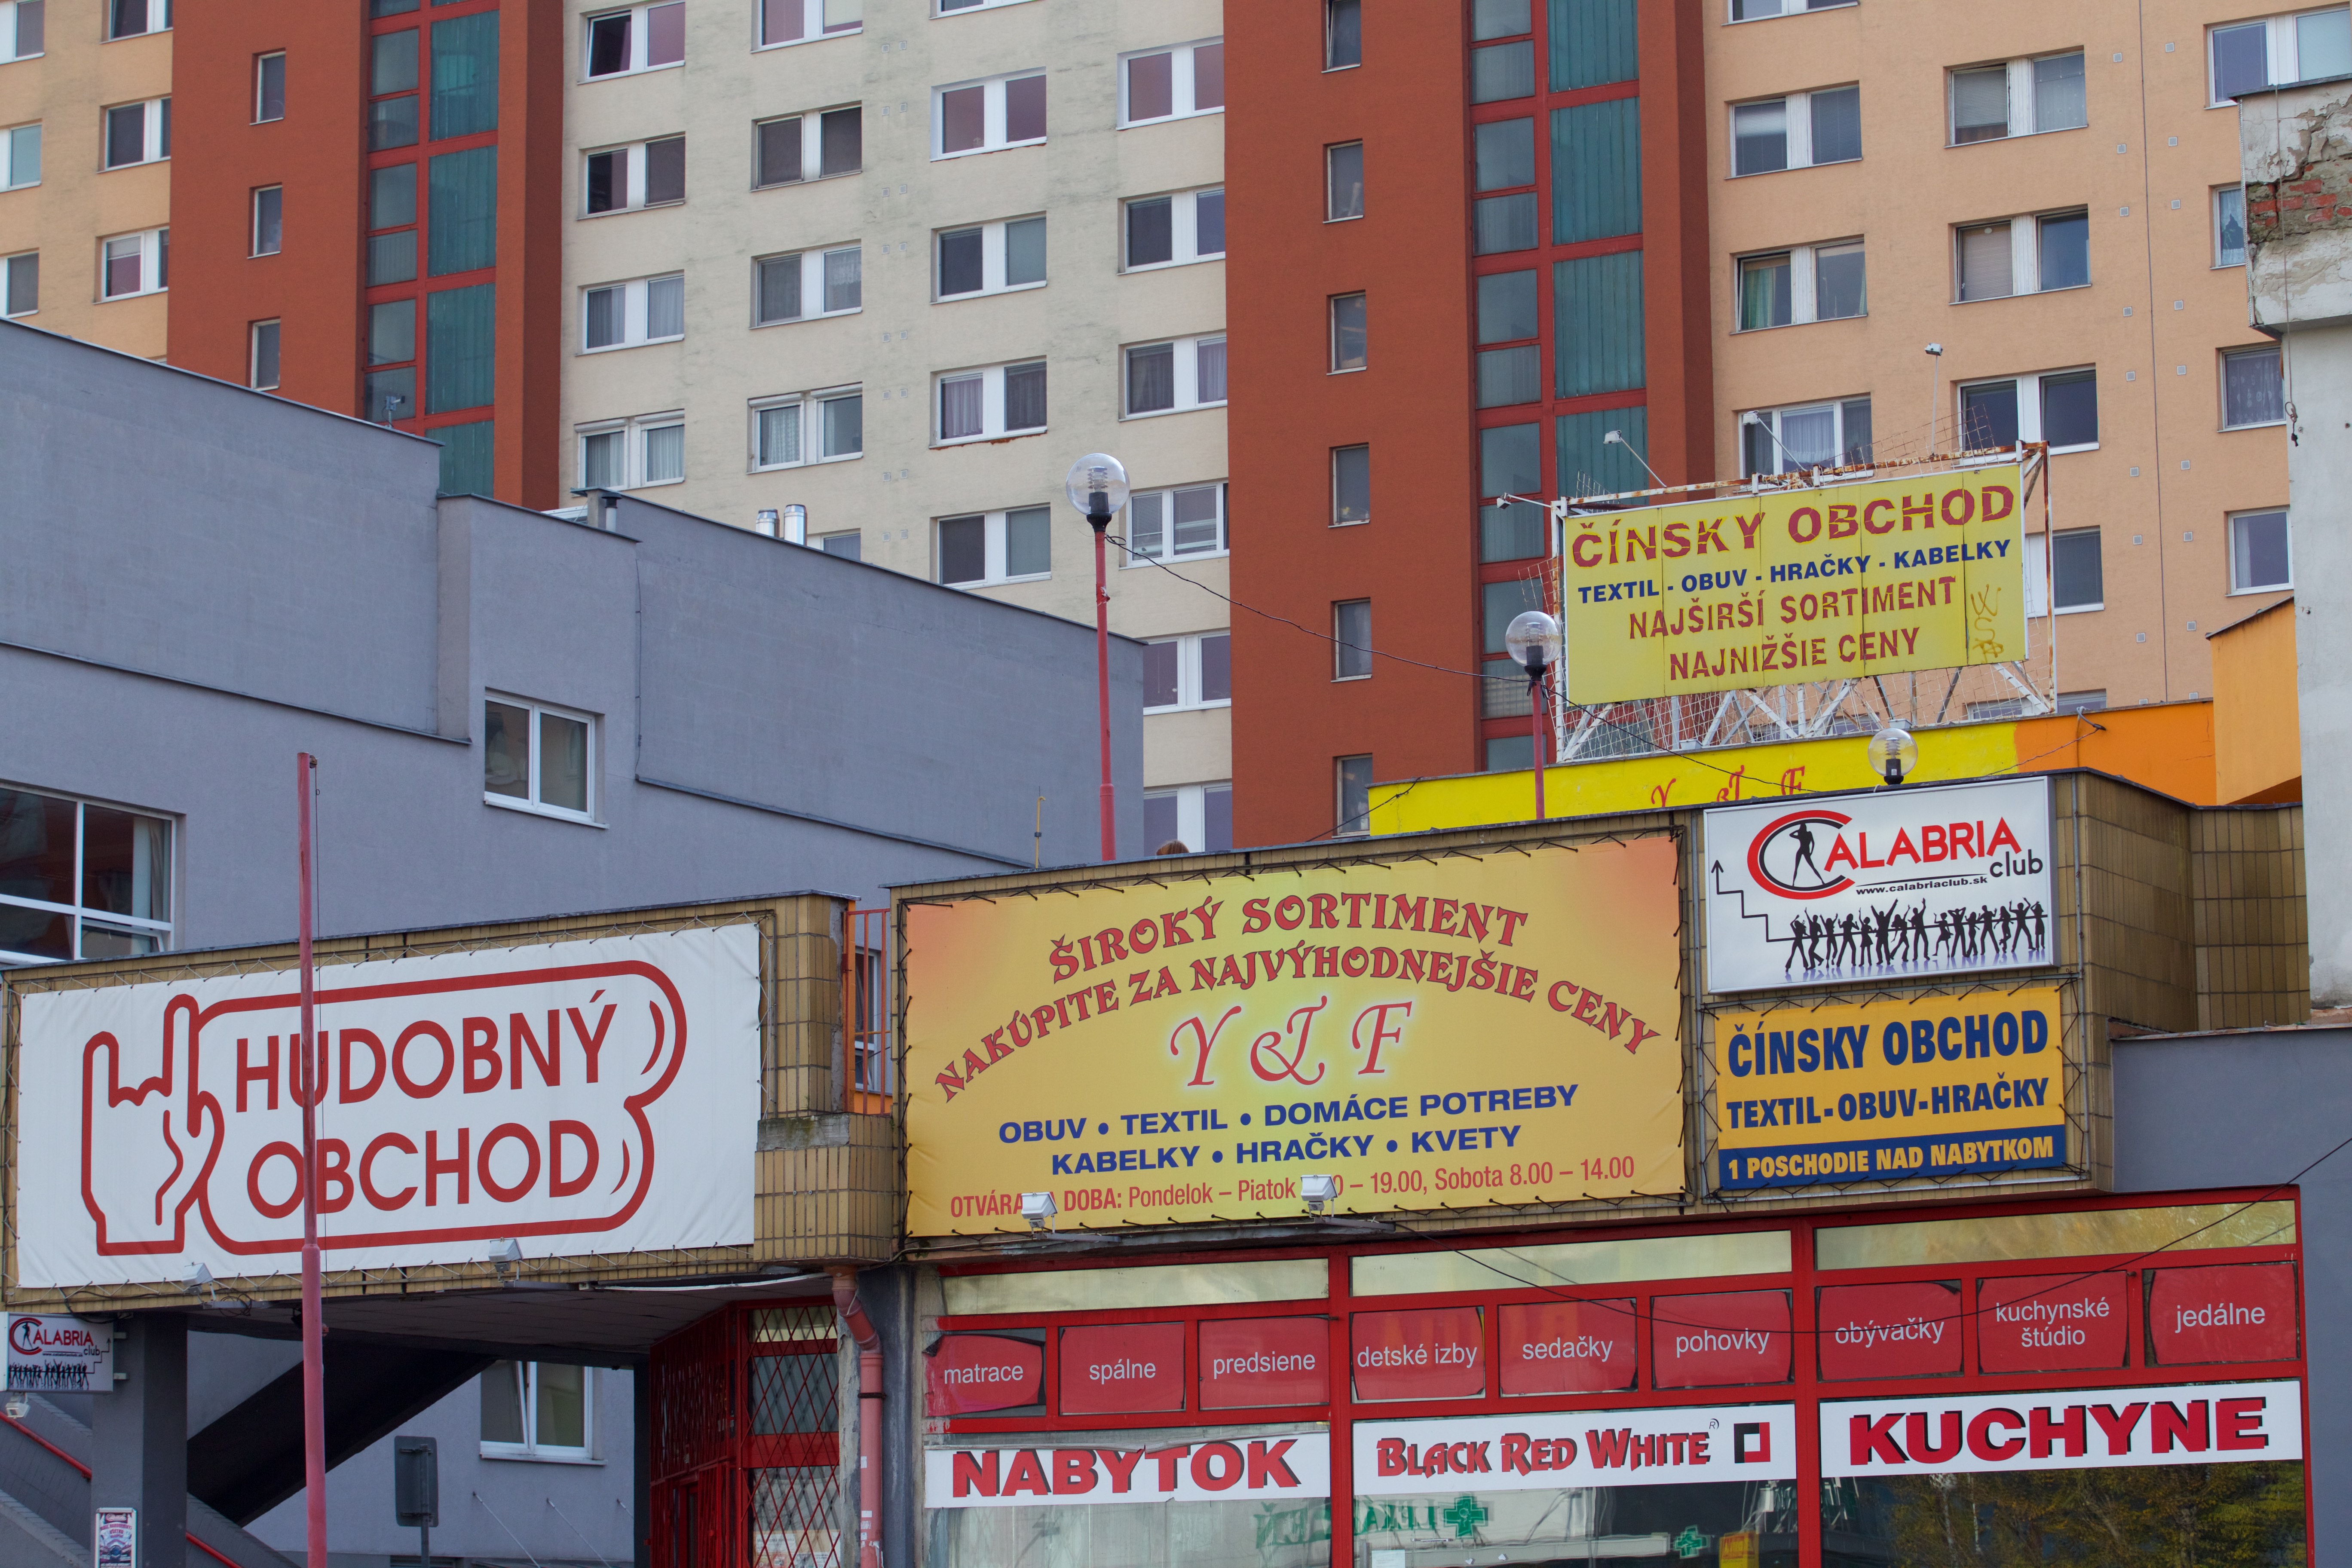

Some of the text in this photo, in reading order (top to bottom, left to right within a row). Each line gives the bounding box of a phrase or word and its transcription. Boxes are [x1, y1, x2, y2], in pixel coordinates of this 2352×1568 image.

[1573, 486, 2013, 567] ČÍNSKY OBCHOD
[1579, 580, 1659, 603] TEXTIL
[1682, 570, 1746, 591] OBUV
[1771, 554, 1869, 582] HRAČKY
[1895, 540, 2009, 568] KABELKY
[1631, 577, 1955, 638] NAJŠIRŠÍ SORTIMENT
[1671, 628, 1918, 680] NAJNIŽŠIE CENY
[1747, 810, 2022, 900] CALABRIA
[1989, 849, 2043, 880] club
[1856, 876, 1988, 895] www.calabriaclub.sk
[1048, 892, 1528, 985] ŠIROKÝ SORTIMENT
[934, 940, 1662, 1103] NAKÚPITE ZA NAJVÝHODNEJŠIE CENY
[1170, 1006, 1242, 1086] Y
[1352, 1001, 1412, 1075] F
[1729, 1011, 2047, 1076] ČÍNSKY OBCHOD
[236, 989, 618, 1112] HUDOBNÝ
[1000, 1085, 1577, 1142] OBUV TEXTIL DOMÁCE POTREBY
[246, 1119, 599, 1219] OBCHOD
[1053, 1126, 1520, 1174] KABELKY HRAČKY KVETY
[1730, 1136, 2052, 1179] 1 POSCHODIE NAD NABYTKOM
[1065, 1188, 1121, 1211] DOBA:
[1130, 1183, 1212, 1207] Pondelok
[1239, 1178, 1295, 1200] Piatok
[1371, 1170, 1427, 1194] 19.00,
[1436, 1167, 1503, 1190] Sobota
[1510, 1162, 1553, 1185] 8.00
[1581, 1156, 1634, 1180] 14.00
[1835, 1316, 1945, 1348] obývačky
[1997, 1297, 2109, 1324] kuchynské
[2175, 1303, 2265, 1333] jedálne
[9, 1317, 94, 1355] CALABRIA
[84, 1345, 100, 1356] club
[1358, 1343, 1477, 1368] detské izby
[1523, 1336, 1612, 1362] sedačky
[1675, 1328, 1770, 1359] pohovky
[2022, 1326, 2085, 1347] štúdio
[945, 1364, 1023, 1384] matrace
[1090, 1359, 1155, 1384] spálne
[1214, 1351, 1315, 1379] predsiene
[1849, 1396, 2269, 1465] KUCHYNE
